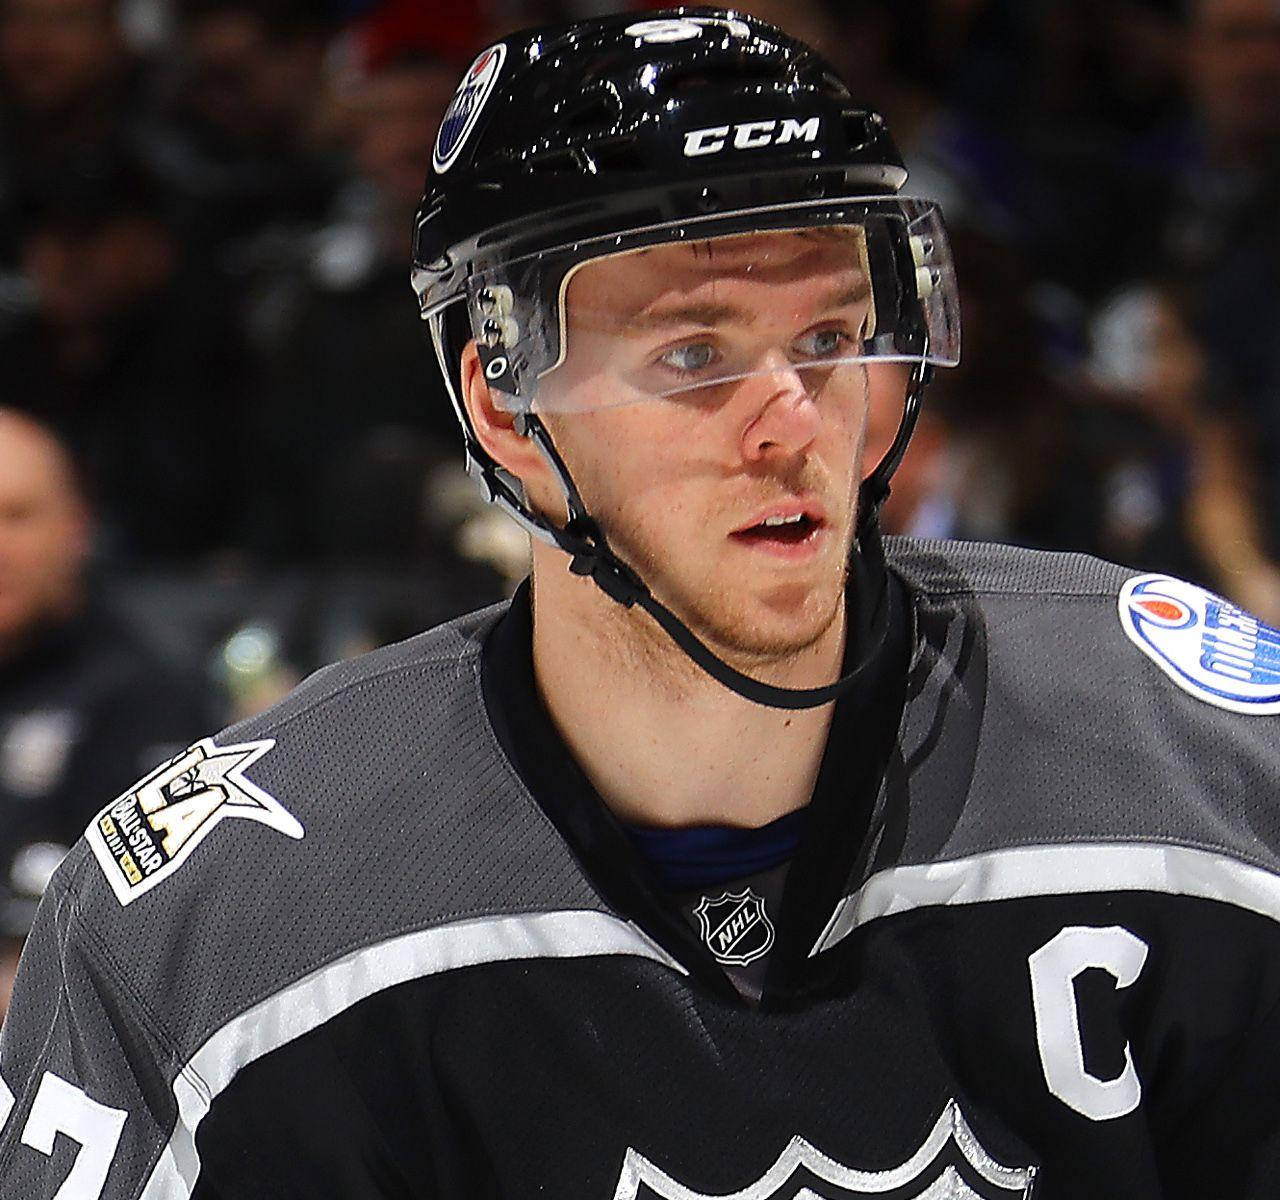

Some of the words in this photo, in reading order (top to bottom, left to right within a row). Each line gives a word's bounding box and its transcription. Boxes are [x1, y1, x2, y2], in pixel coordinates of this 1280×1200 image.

[683, 117, 819, 157] CCM
[718, 907, 756, 951] NHL
[1028, 924, 1150, 1122] C
